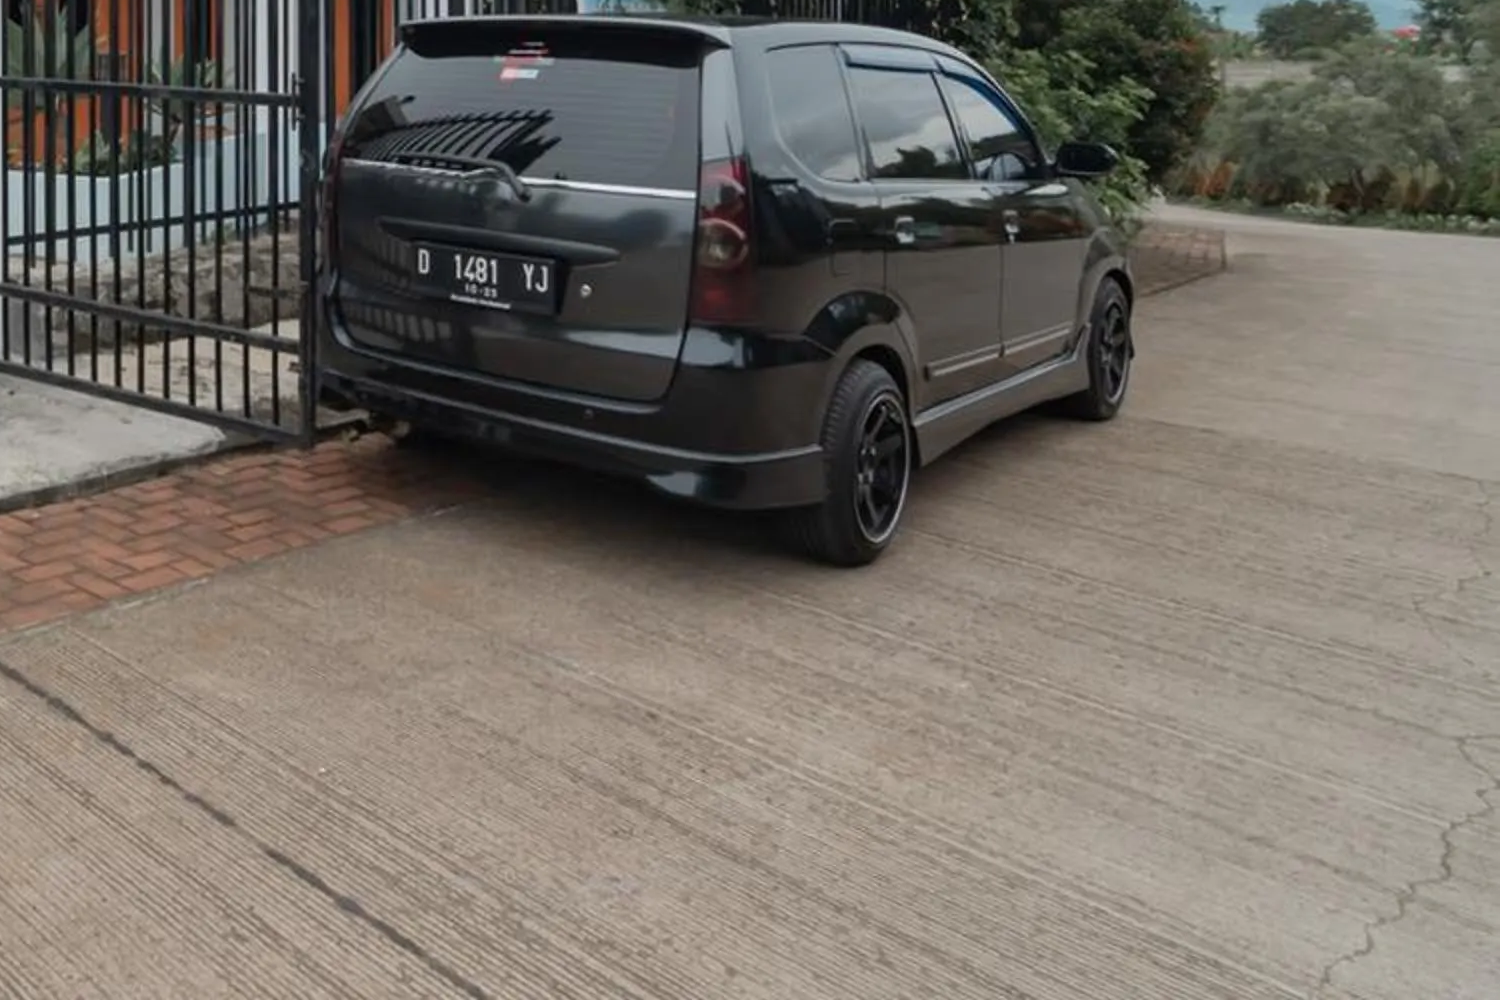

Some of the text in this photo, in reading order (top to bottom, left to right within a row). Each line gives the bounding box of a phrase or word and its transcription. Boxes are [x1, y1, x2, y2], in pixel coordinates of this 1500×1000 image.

[418, 249, 549, 293] D 1481 YJ
